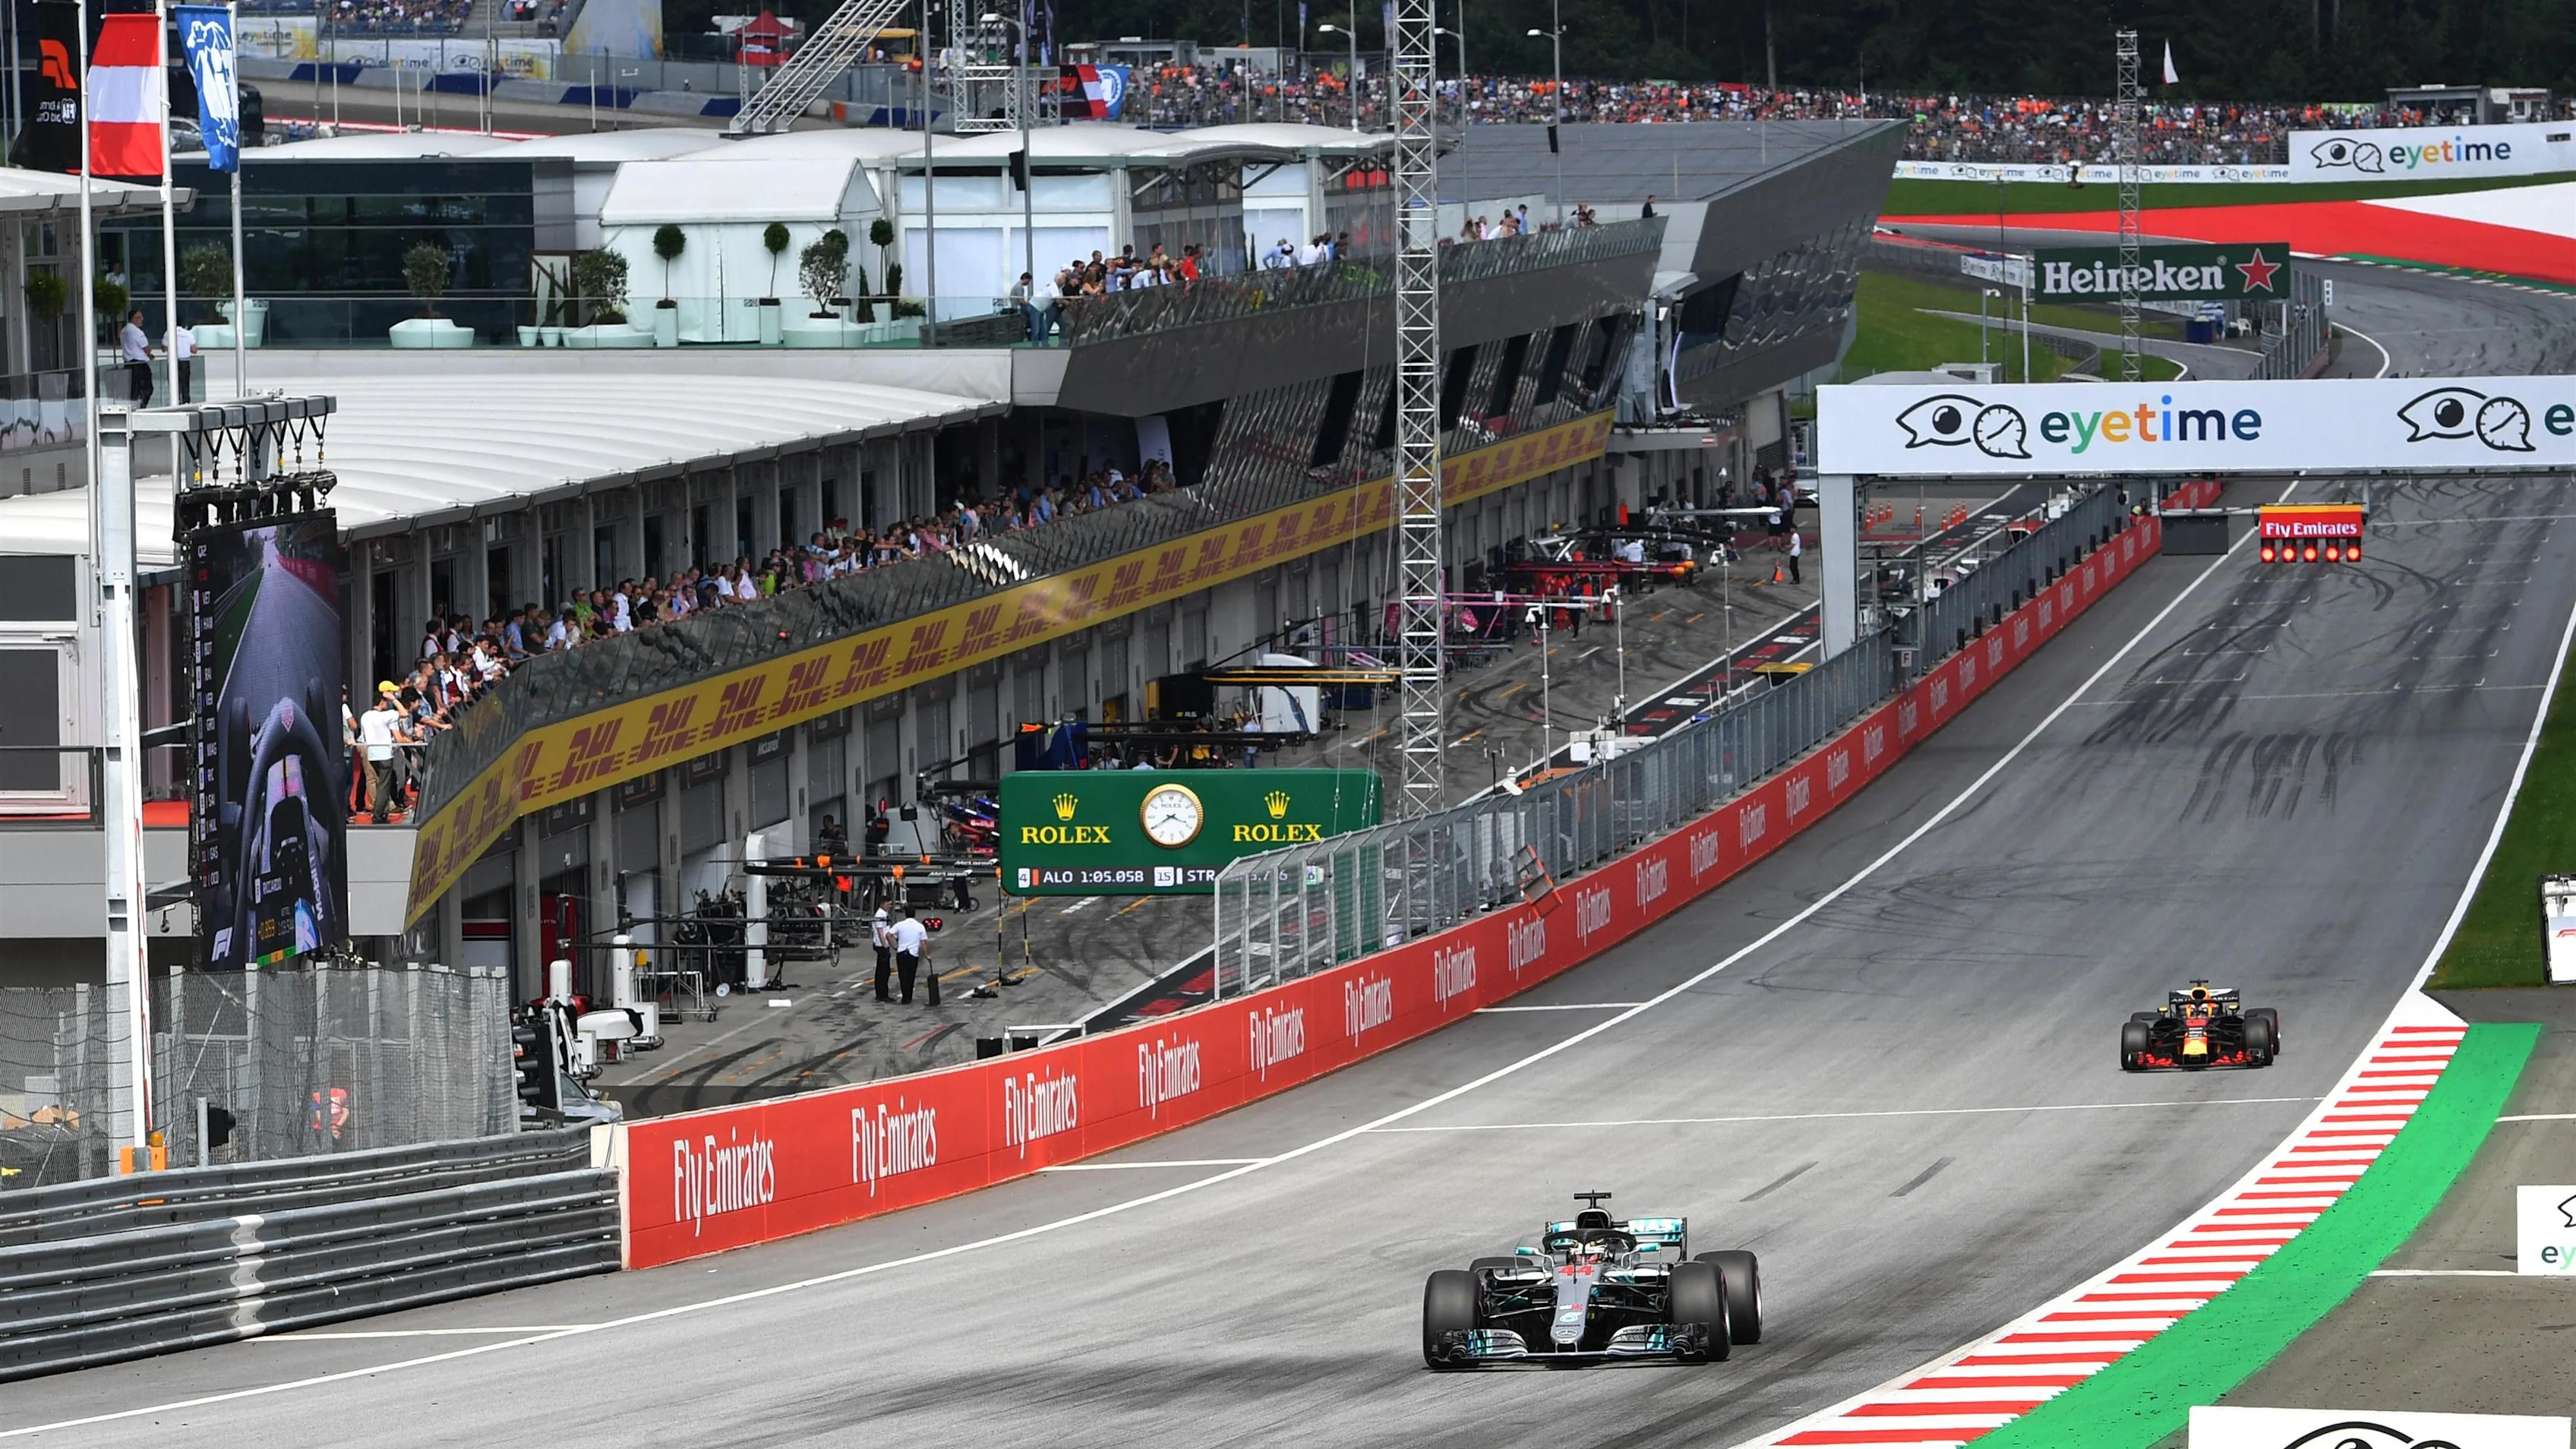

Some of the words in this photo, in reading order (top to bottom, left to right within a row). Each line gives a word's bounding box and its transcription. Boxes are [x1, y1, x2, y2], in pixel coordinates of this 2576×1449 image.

[2389, 135, 2511, 169] eyetime
[2042, 259, 2226, 295] Heineken
[2041, 395, 2263, 453] eyetime
[2265, 522, 2290, 538] Fly
[2293, 521, 2358, 536] Emirates
[1021, 826, 1111, 844] ROLEX
[1233, 823, 1322, 842] ROLEX
[1043, 871, 1073, 884] ALO
[1081, 870, 1144, 883] 1:05.058
[1157, 871, 1171, 882] 15
[1187, 870, 1215, 882] STR
[1434, 950, 1447, 1012] Fly
[1447, 939, 1476, 999] Emirates
[1344, 980, 1359, 1047] Fly
[1359, 970, 1392, 1033] Emirates
[1250, 1012, 1266, 1082] Fly
[1266, 999, 1305, 1065] Emirates
[1138, 1043, 1157, 1119] Fly
[1157, 1031, 1201, 1103] Emirates
[1004, 1078, 1026, 1159] Fly
[1026, 1065, 1078, 1141] Emirates
[851, 1107, 876, 1197] Fly
[877, 1095, 937, 1176] Emirates
[674, 1139, 702, 1237] Fly
[704, 1125, 775, 1216] Emirates
[1558, 1265, 1595, 1276] 44
